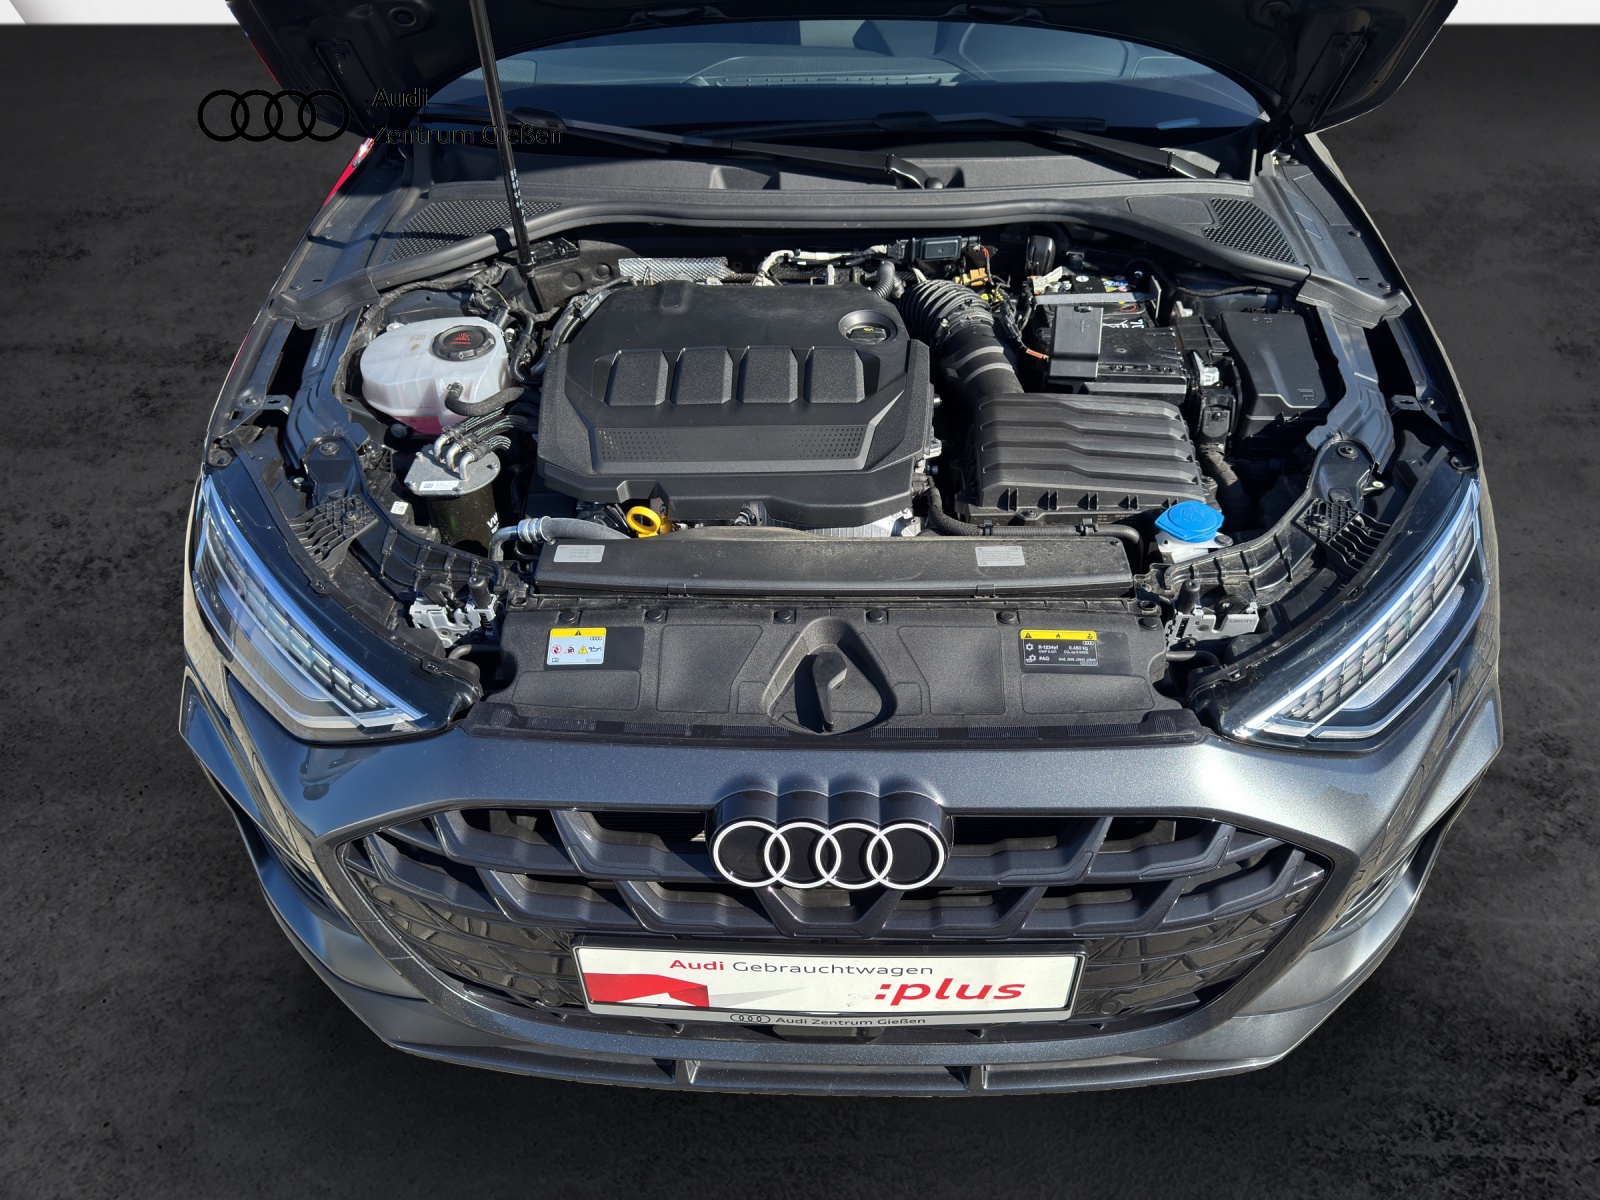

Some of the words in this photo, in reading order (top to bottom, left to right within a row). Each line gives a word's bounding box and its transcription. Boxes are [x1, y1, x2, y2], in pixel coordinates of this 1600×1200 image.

[669, 959, 724, 971] Audi
[732, 961, 933, 977] Gebrauchtwagen
[874, 977, 1026, 1007] :plus
[775, 1017, 808, 1025] Audi
[811, 1018, 873, 1026] Zentrum
[877, 1017, 926, 1026] Gießen
